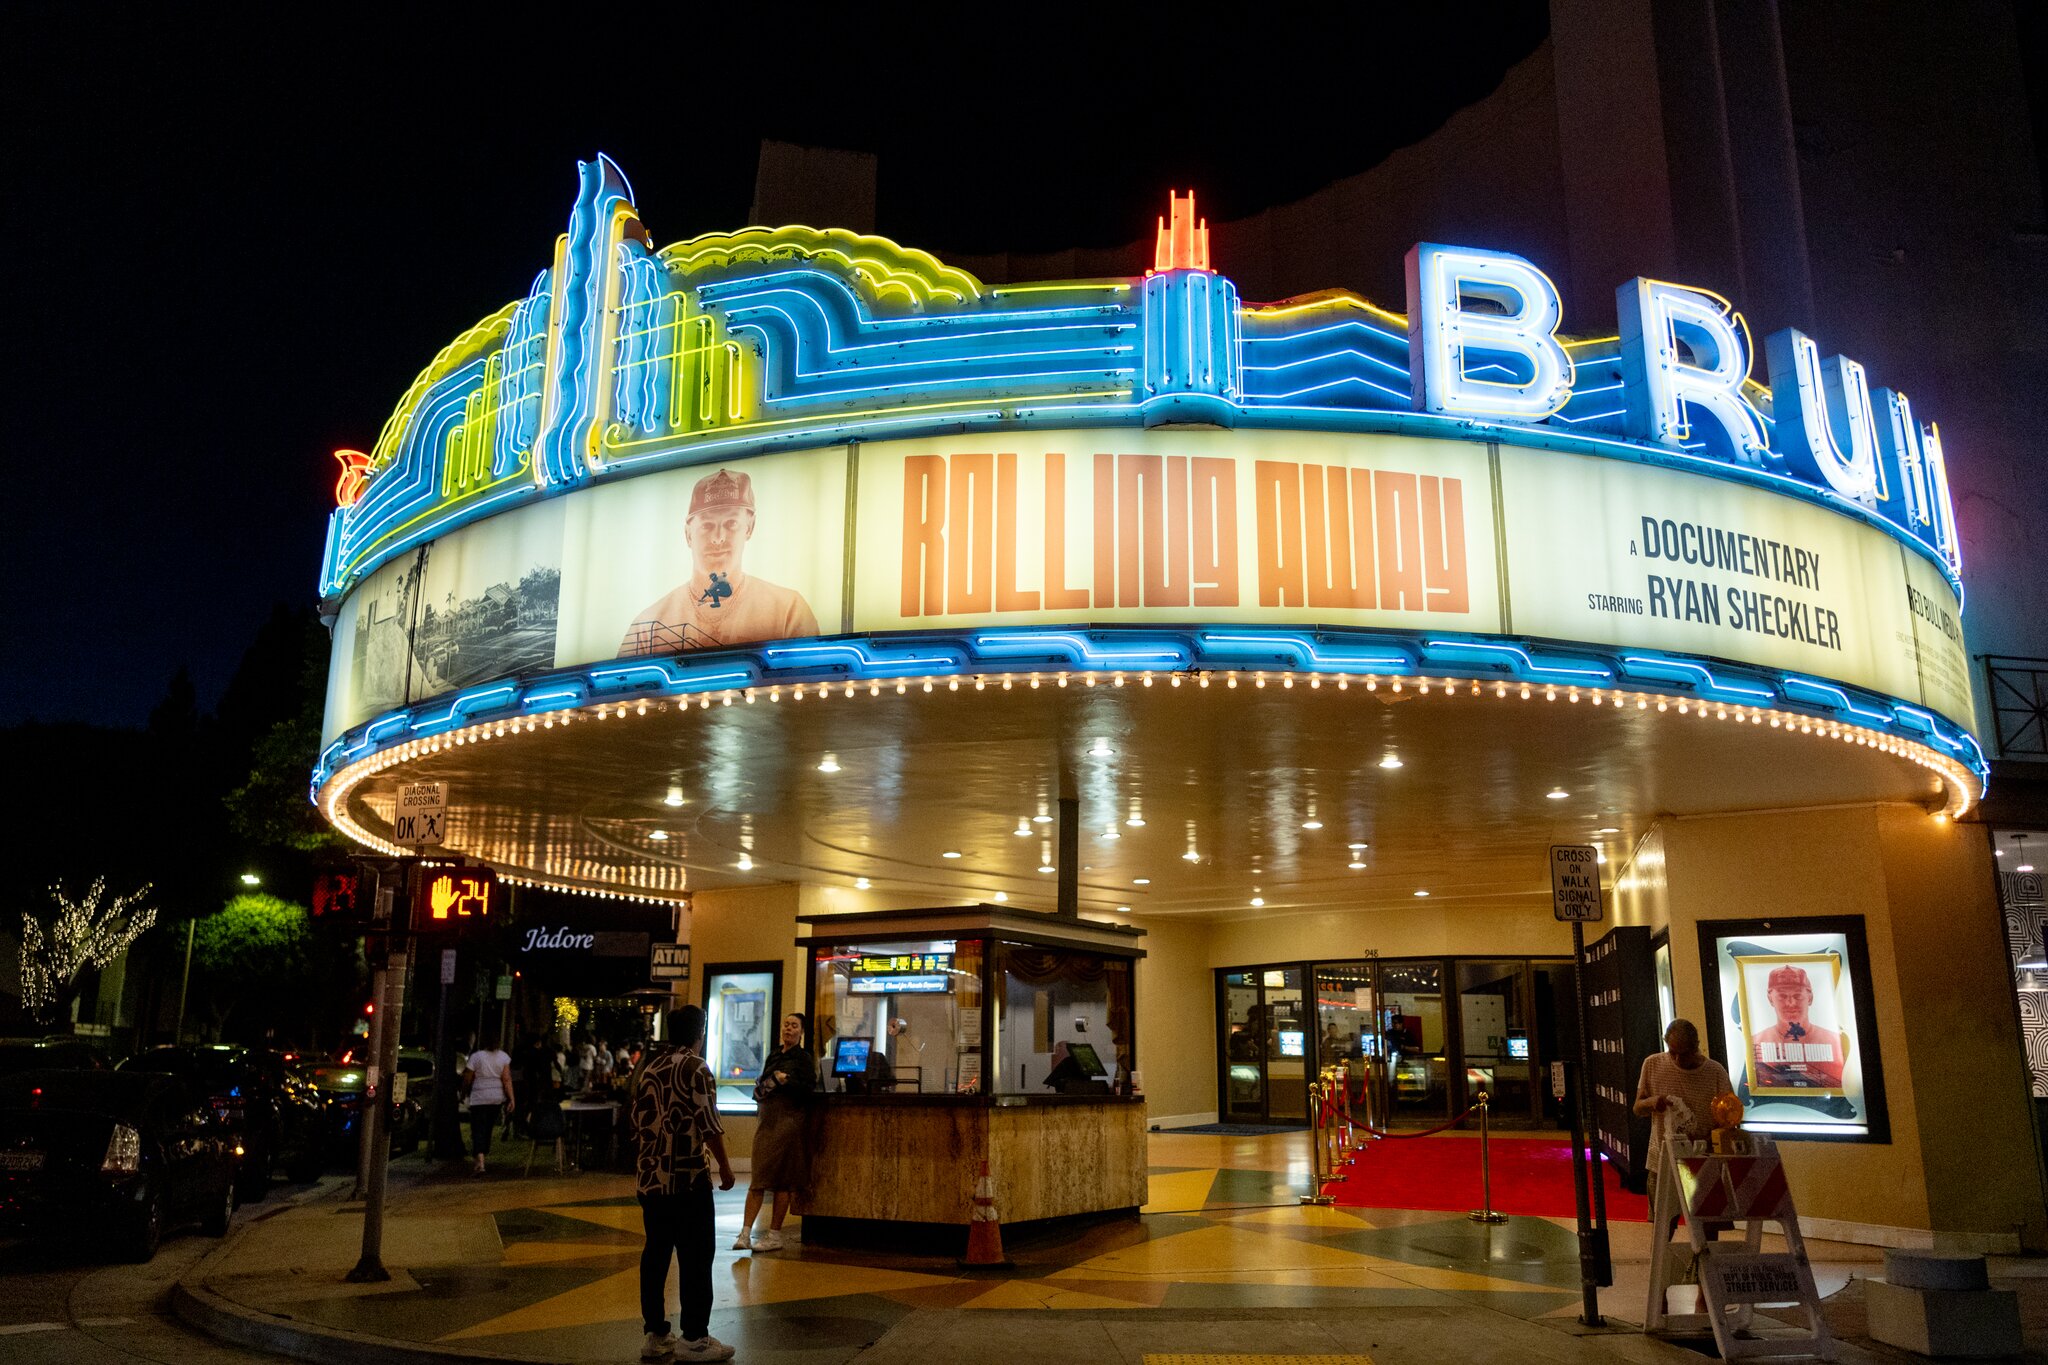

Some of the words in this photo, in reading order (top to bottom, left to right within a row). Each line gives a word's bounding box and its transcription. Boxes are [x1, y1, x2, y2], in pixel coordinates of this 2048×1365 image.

[901, 453, 1239, 617] ROLLING
[1255, 460, 1470, 614] AWAY
[1630, 539, 1638, 556] A
[1641, 515, 1820, 592] DOCUMENTARY
[1588, 593, 1643, 615] STARRING
[1647, 574, 1721, 626] RYAN
[1727, 586, 1842, 651] SHECKLER
[404, 784, 440, 796] DIAGONAL
[403, 795, 440, 807] CROSSING
[397, 816, 415, 839] OK
[1557, 850, 1591, 862] CROSS
[1569, 864, 1581, 873] ON
[1562, 876, 1590, 887] WALK
[458, 880, 489, 915] 24
[1559, 890, 1596, 902] SIGNAL
[1565, 905, 1591, 917] ONLY
[521, 926, 594, 952] J'adore
[653, 949, 689, 964] ATM
[1364, 949, 1378, 958] 948
[1726, 1282, 1756, 1292] STREET
[1759, 1280, 1799, 1292] SERVICES
